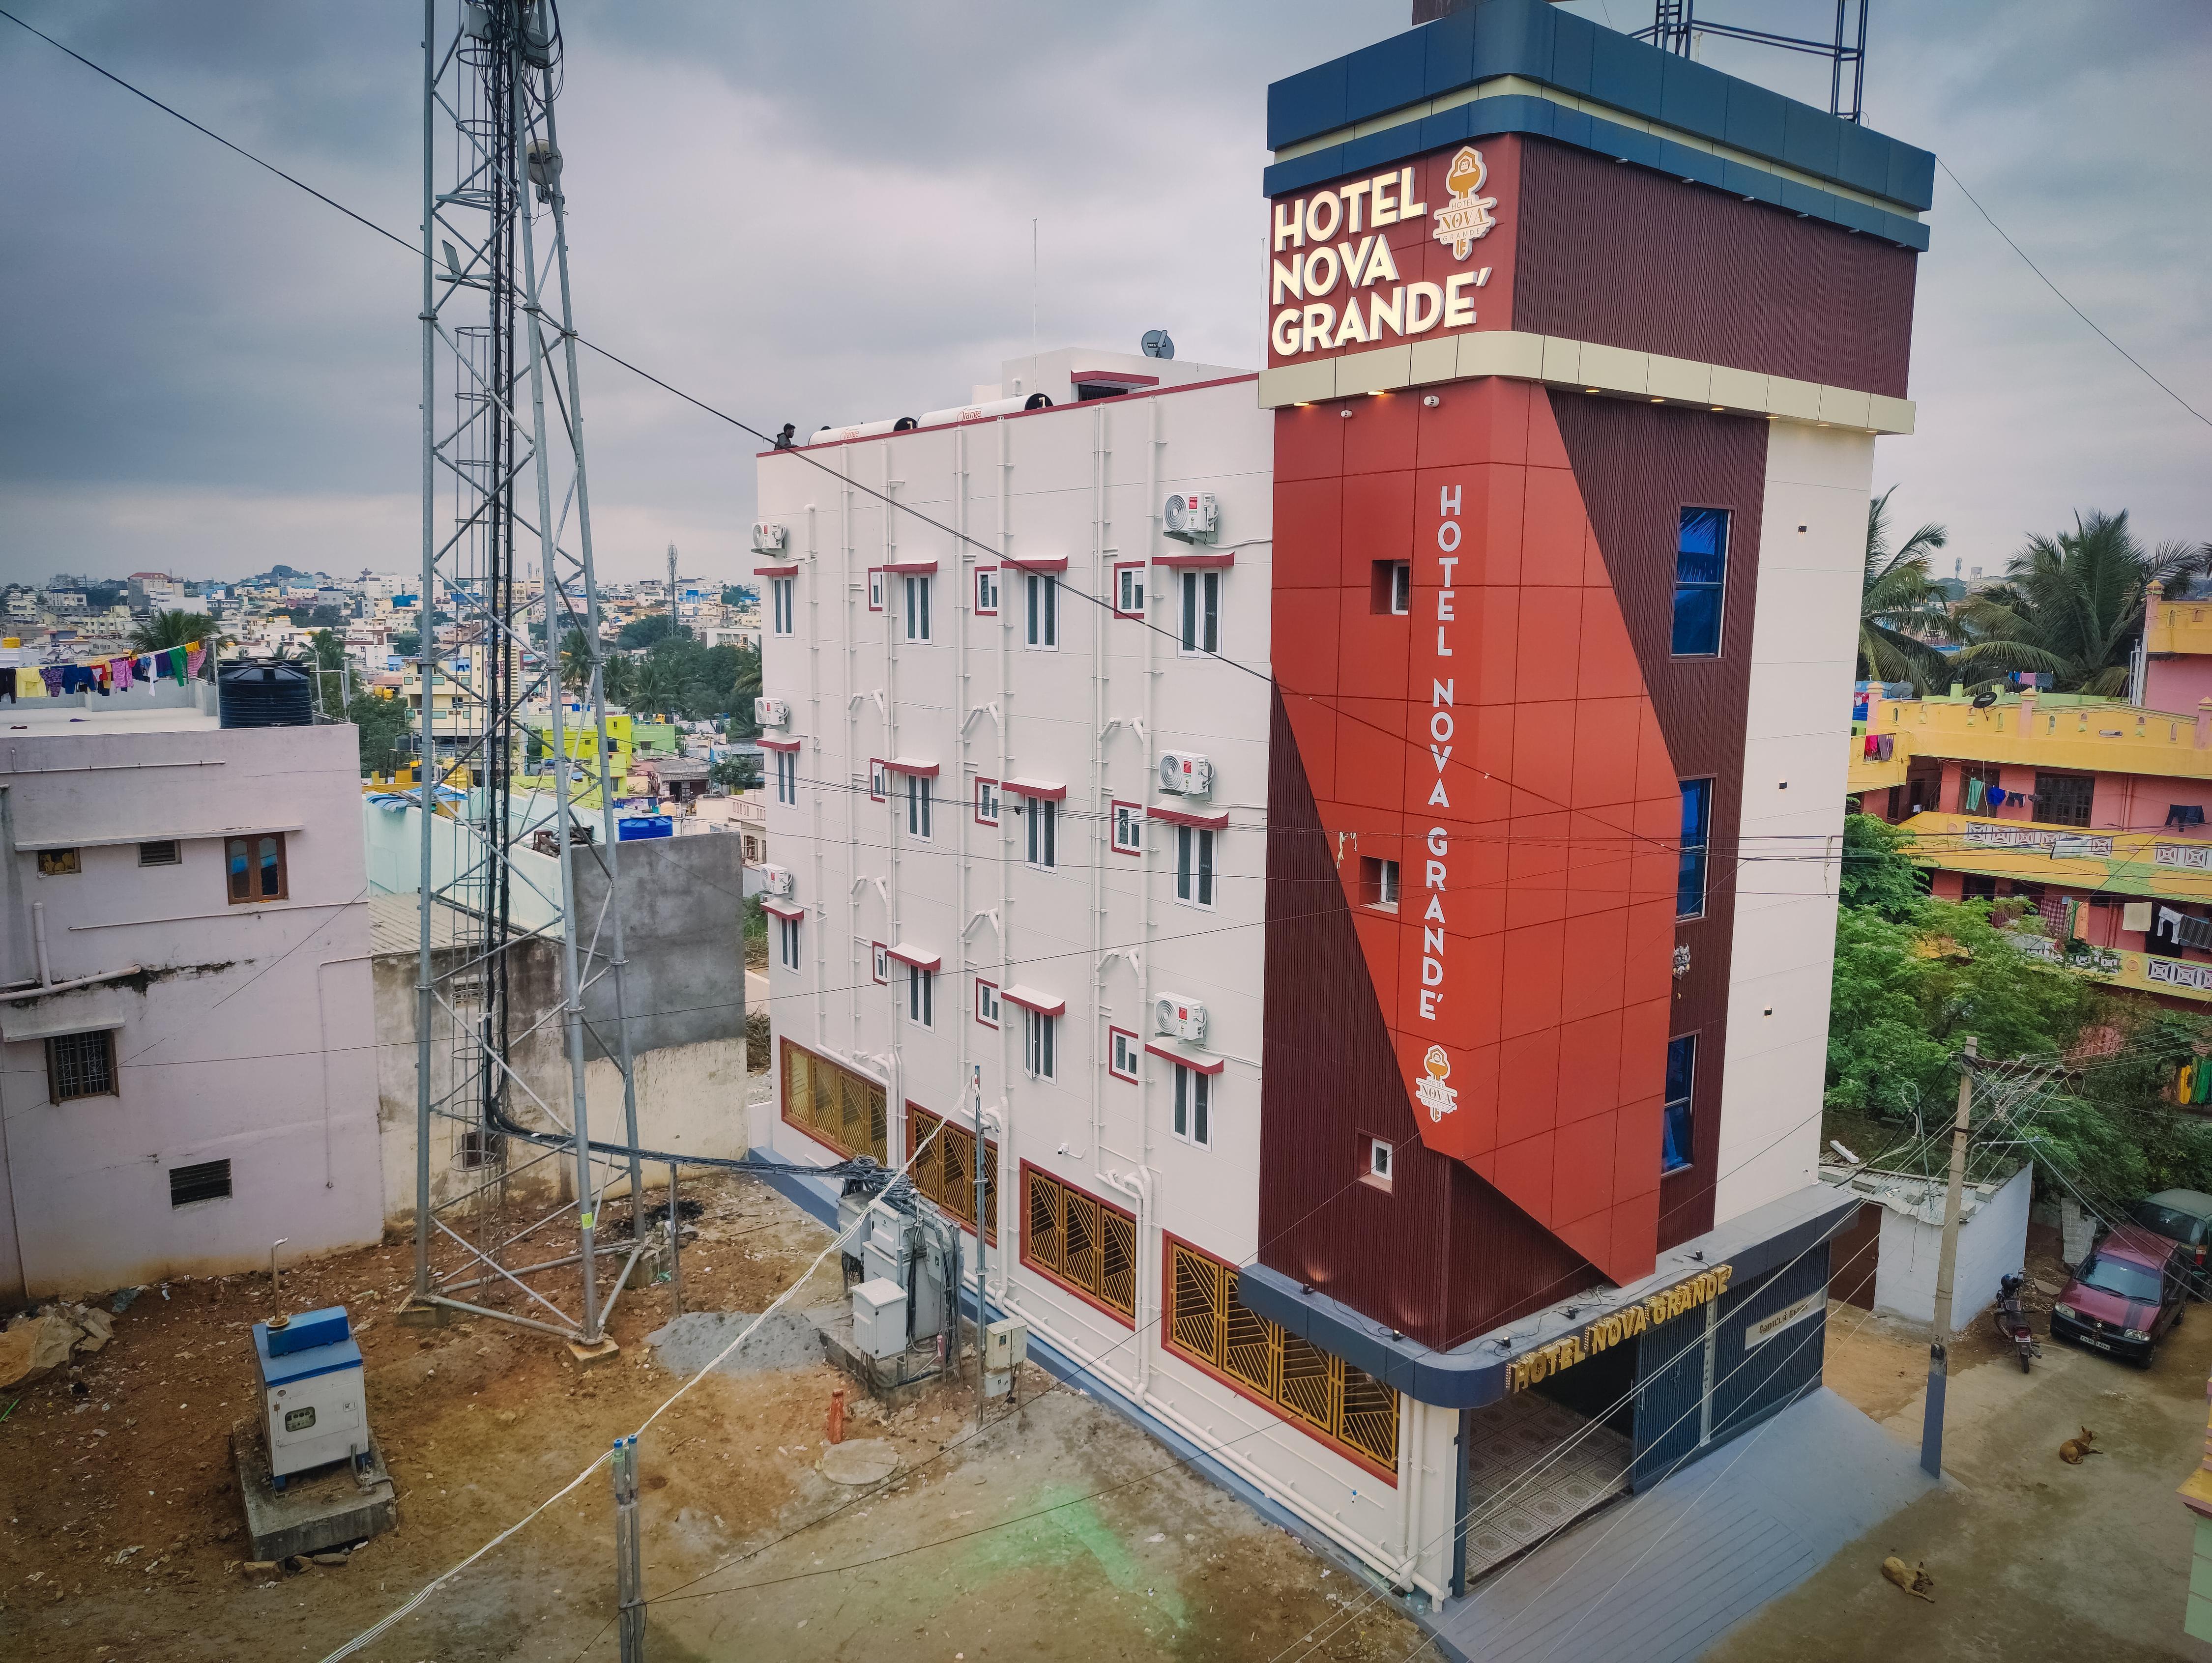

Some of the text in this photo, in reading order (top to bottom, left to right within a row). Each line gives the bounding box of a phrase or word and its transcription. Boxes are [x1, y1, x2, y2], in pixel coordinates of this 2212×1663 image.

[1275, 167, 1427, 252] HOTEL
[1442, 208, 1484, 231] NOVA
[1452, 199, 1474, 210] HOTEL
[1273, 233, 1400, 305] NOVA
[957, 410, 982, 422] Orange
[1437, 485, 1461, 656] HOTEL
[1427, 678, 1455, 808] NOVA
[1421, 1085, 1451, 1104] NOVA
[1428, 1079, 1444, 1088] HOTEL
[1510, 1335, 1585, 1393] HOTEL
[1588, 1306, 1647, 1355] NOVA
